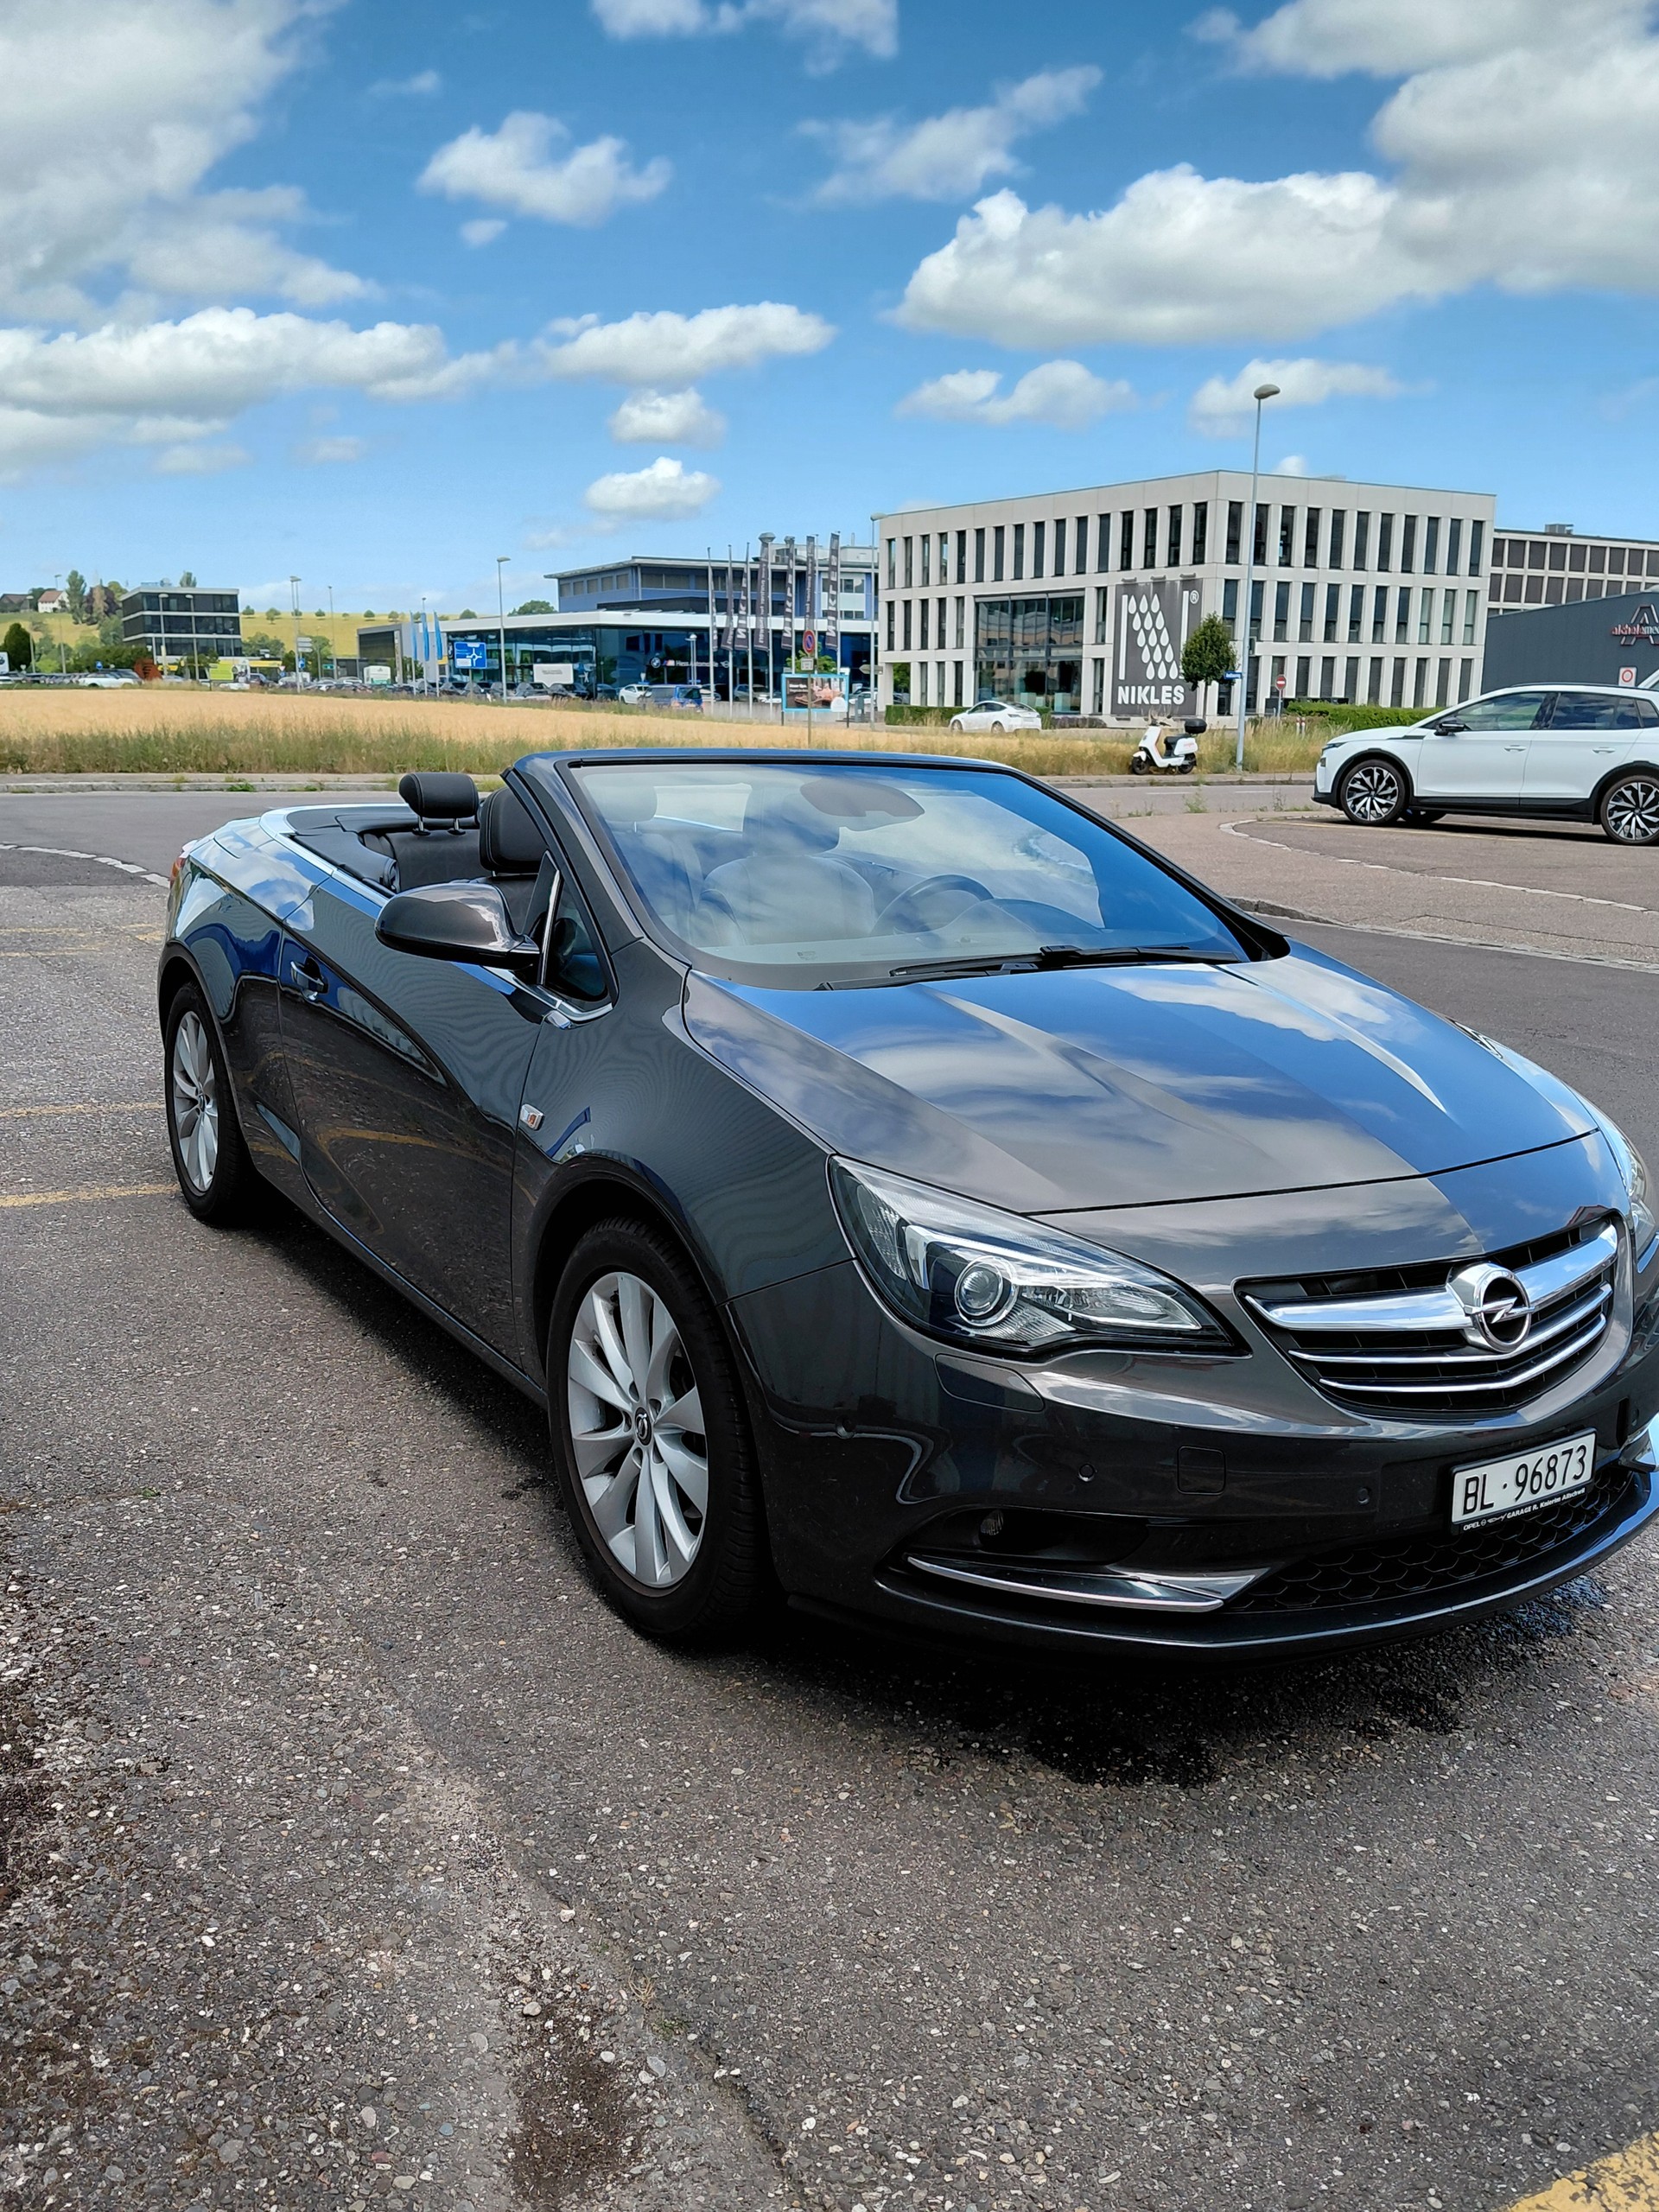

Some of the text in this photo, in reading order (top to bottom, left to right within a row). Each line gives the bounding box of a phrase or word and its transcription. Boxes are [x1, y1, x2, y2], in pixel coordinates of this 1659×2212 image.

[1117, 685, 1185, 705] NIKLES
[1463, 1473, 1494, 1516] BL
[1515, 1445, 1586, 1502] 96873
[1463, 1522, 1480, 1531] OPEL
[1507, 1506, 1532, 1519] GARAGE
